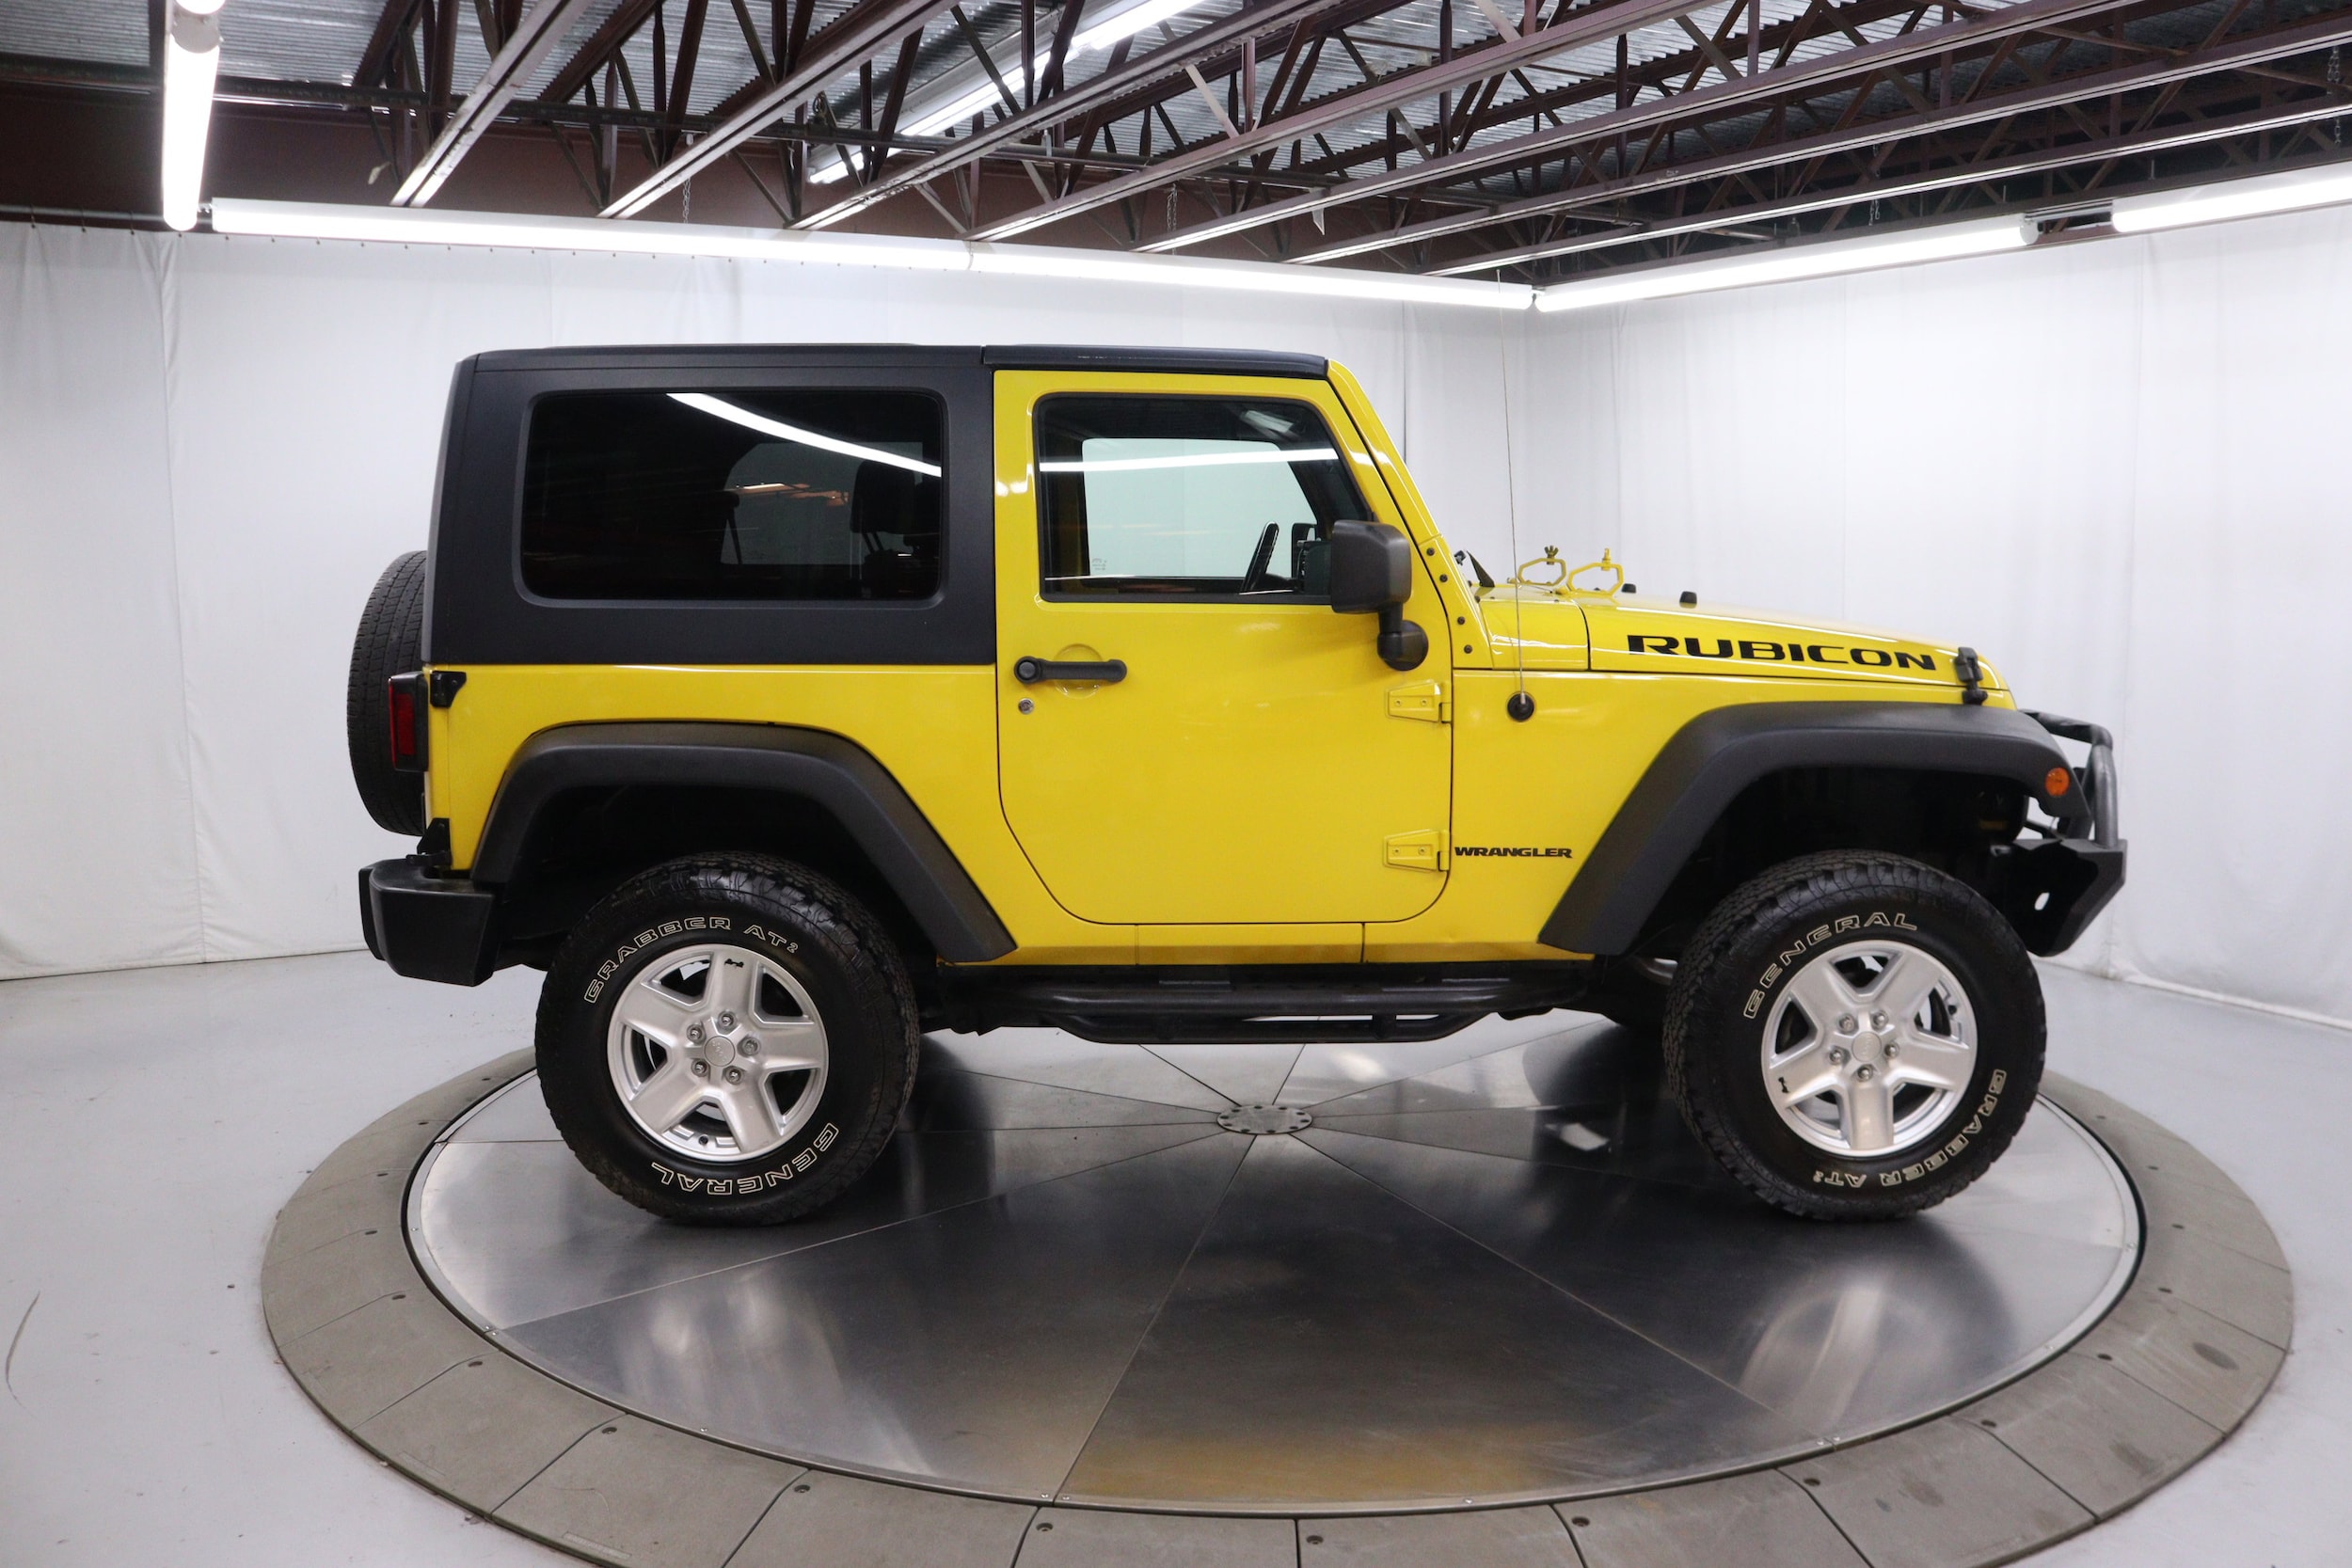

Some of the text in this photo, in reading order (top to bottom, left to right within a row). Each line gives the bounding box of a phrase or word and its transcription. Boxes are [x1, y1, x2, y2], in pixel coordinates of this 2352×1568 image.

[1627, 635, 1936, 671] RUBICON
[1454, 847, 1573, 859] WRANGLER
[583, 916, 731, 1004] GRABBER
[1743, 912, 1918, 1019] GENERAL
[651, 1122, 840, 1196] GENERAL
[1880, 1069, 2007, 1187] GRABBER
